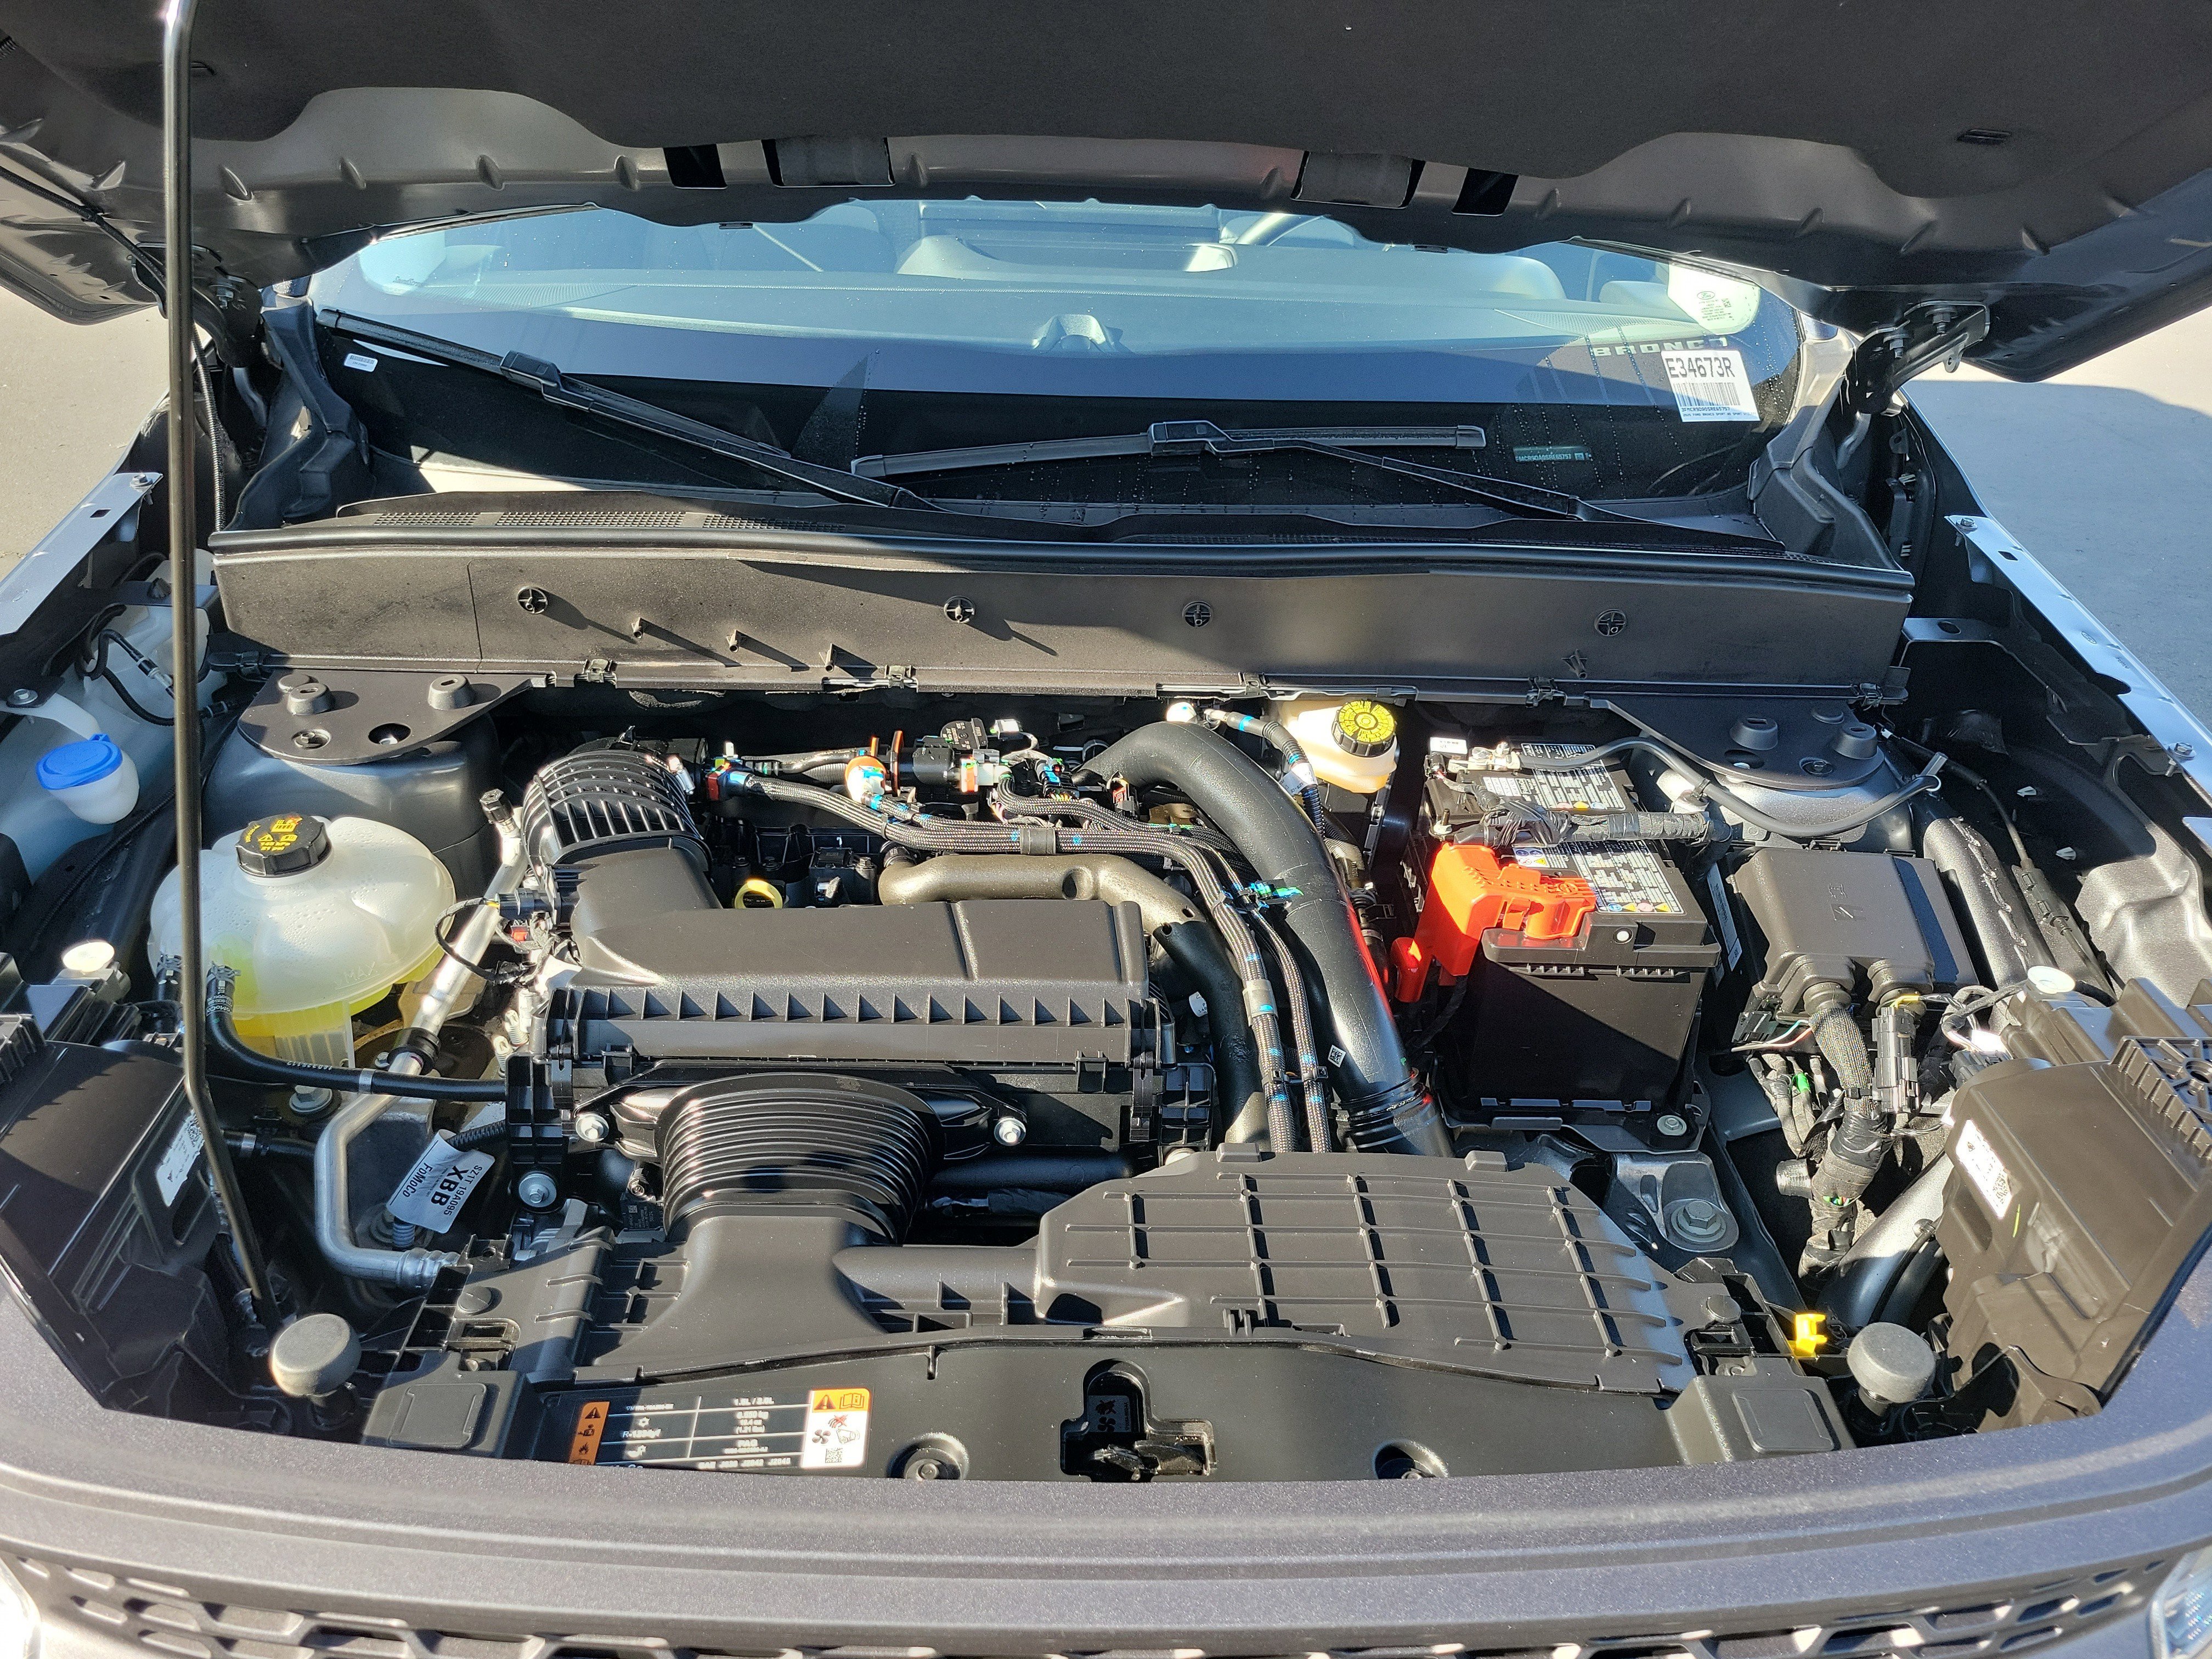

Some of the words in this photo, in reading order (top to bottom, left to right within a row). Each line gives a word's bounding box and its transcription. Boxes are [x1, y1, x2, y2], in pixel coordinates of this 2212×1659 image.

[1664, 357, 1735, 378] E34673R
[402, 1163, 433, 1198] FoMoCo
[430, 1165, 470, 1206] XBB
[465, 1165, 483, 1184] SZ1T
[443, 1186, 467, 1216] 19A095
[768, 1457, 791, 1465] J2845
